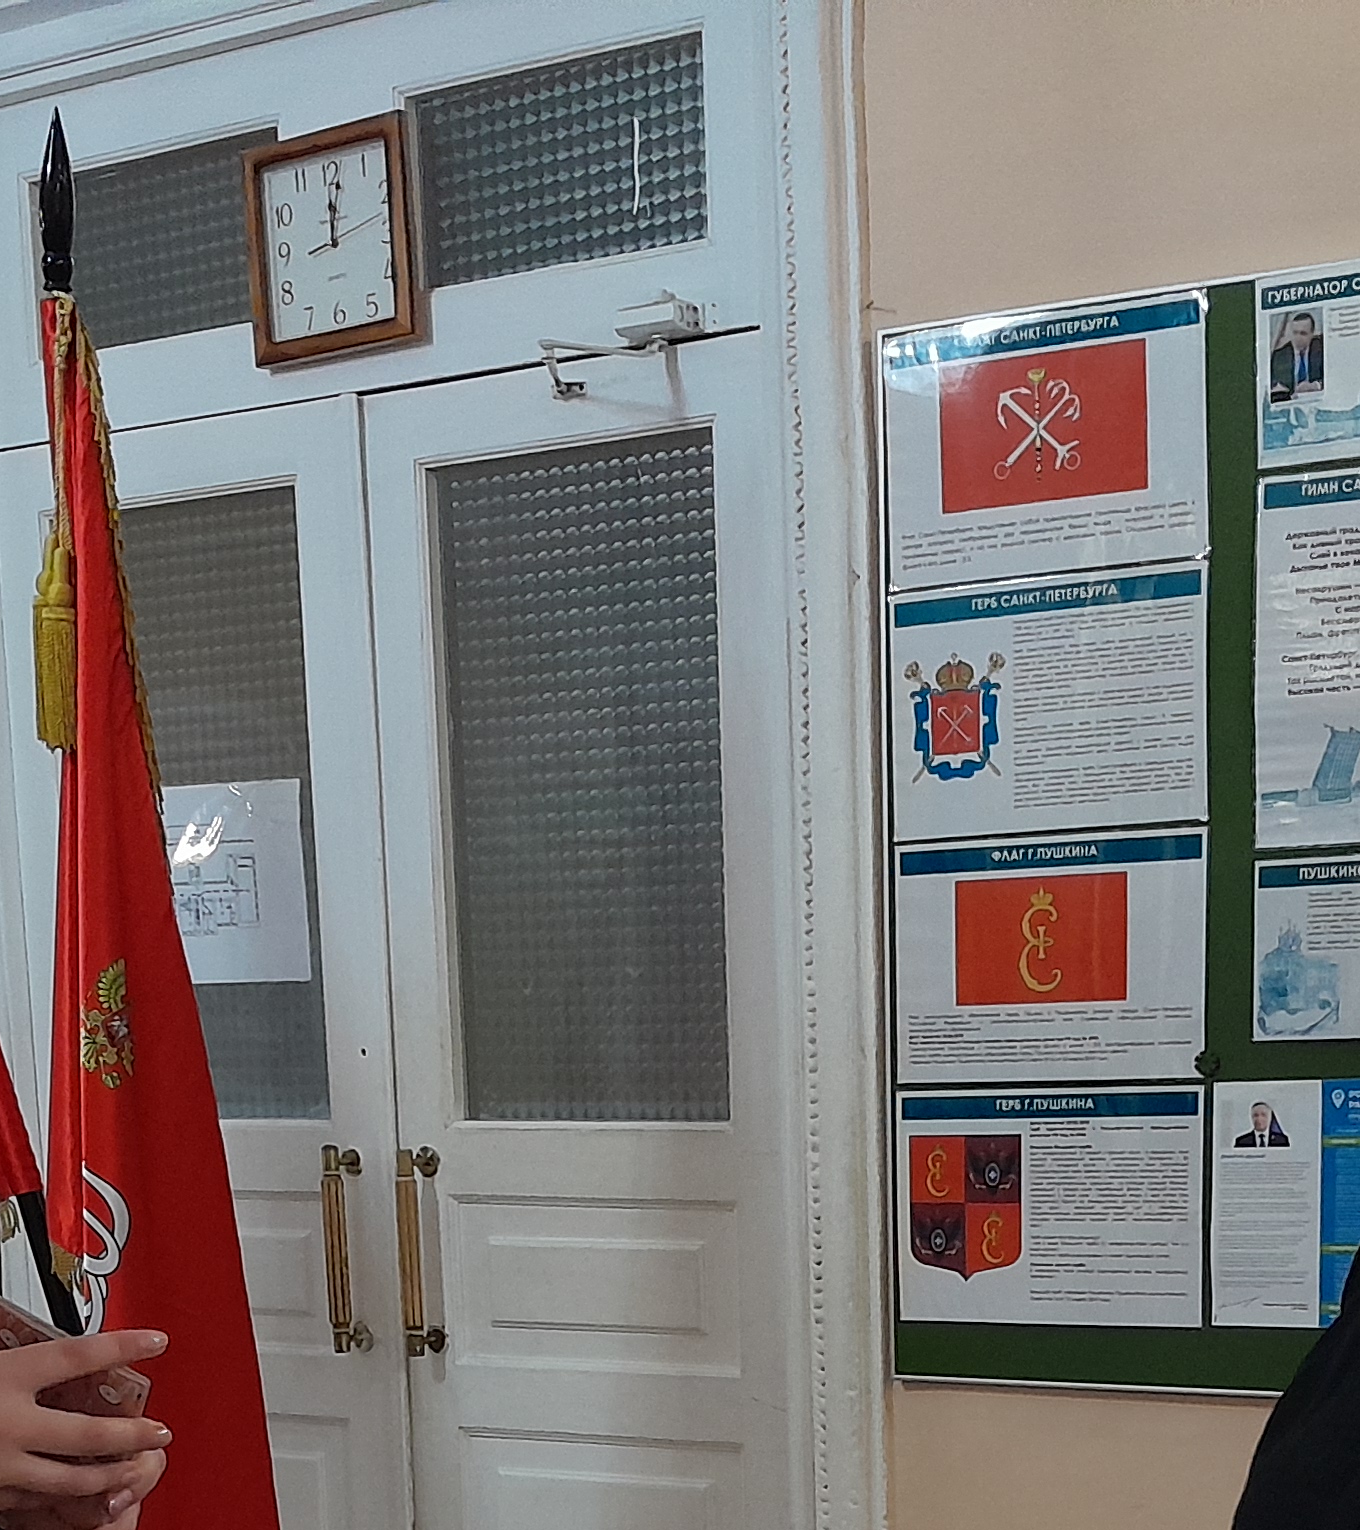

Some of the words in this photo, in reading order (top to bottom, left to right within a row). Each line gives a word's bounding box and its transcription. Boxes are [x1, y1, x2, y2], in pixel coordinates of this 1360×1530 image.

[322, 161, 340, 187] 12
[361, 153, 367, 177] 1
[294, 167, 307, 193] 11
[275, 203, 293, 228] 10
[278, 242, 291, 267] 9
[281, 280, 294, 306] 8
[1267, 280, 1348, 304] ГУБЕРНАТОР
[304, 305, 314, 331] 7
[333, 301, 346, 325] 6
[366, 293, 379, 318] 5
[1001, 316, 1120, 344] САНКТ-ПЕТЕРБУРГА
[1301, 481, 1339, 497] ГИМН
[971, 598, 998, 611] ГЕРБ
[1000, 584, 1118, 608] САНКТ-ПЕТЕРБУРГА
[991, 848, 1025, 861] ФЛАГ
[1024, 1098, 1094, 1111] Г.ПУШКИНА
